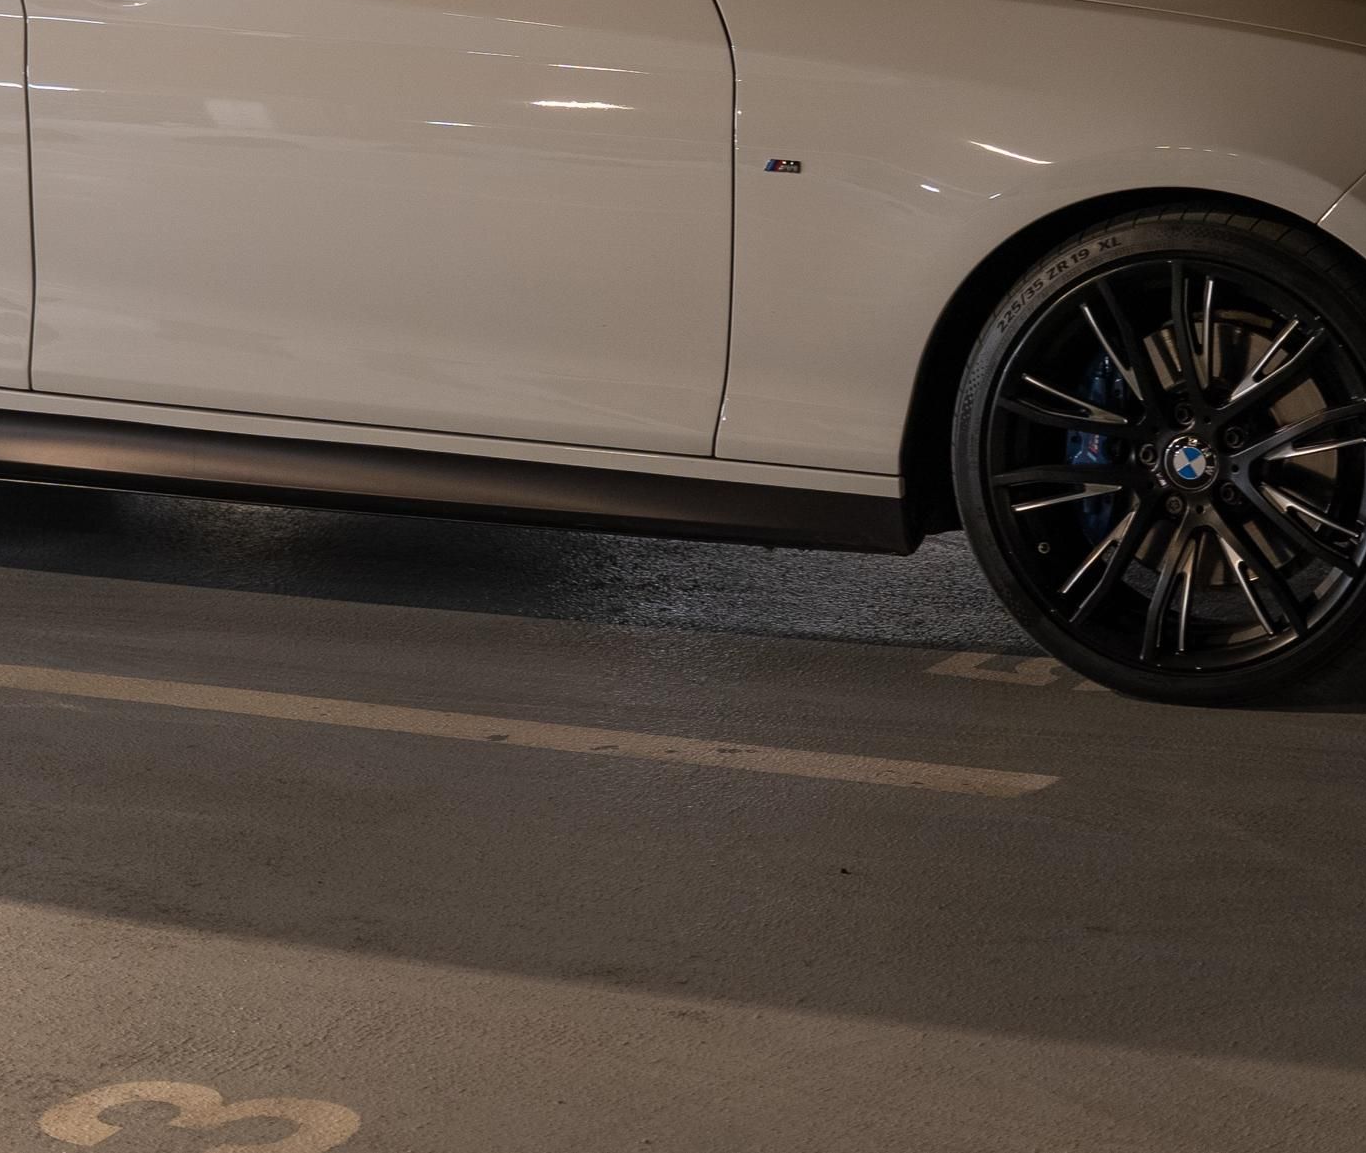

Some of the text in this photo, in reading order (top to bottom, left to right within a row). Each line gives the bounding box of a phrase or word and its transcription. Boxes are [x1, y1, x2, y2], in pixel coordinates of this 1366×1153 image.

[996, 236, 1122, 334] 225/35 ZR 19 XL
